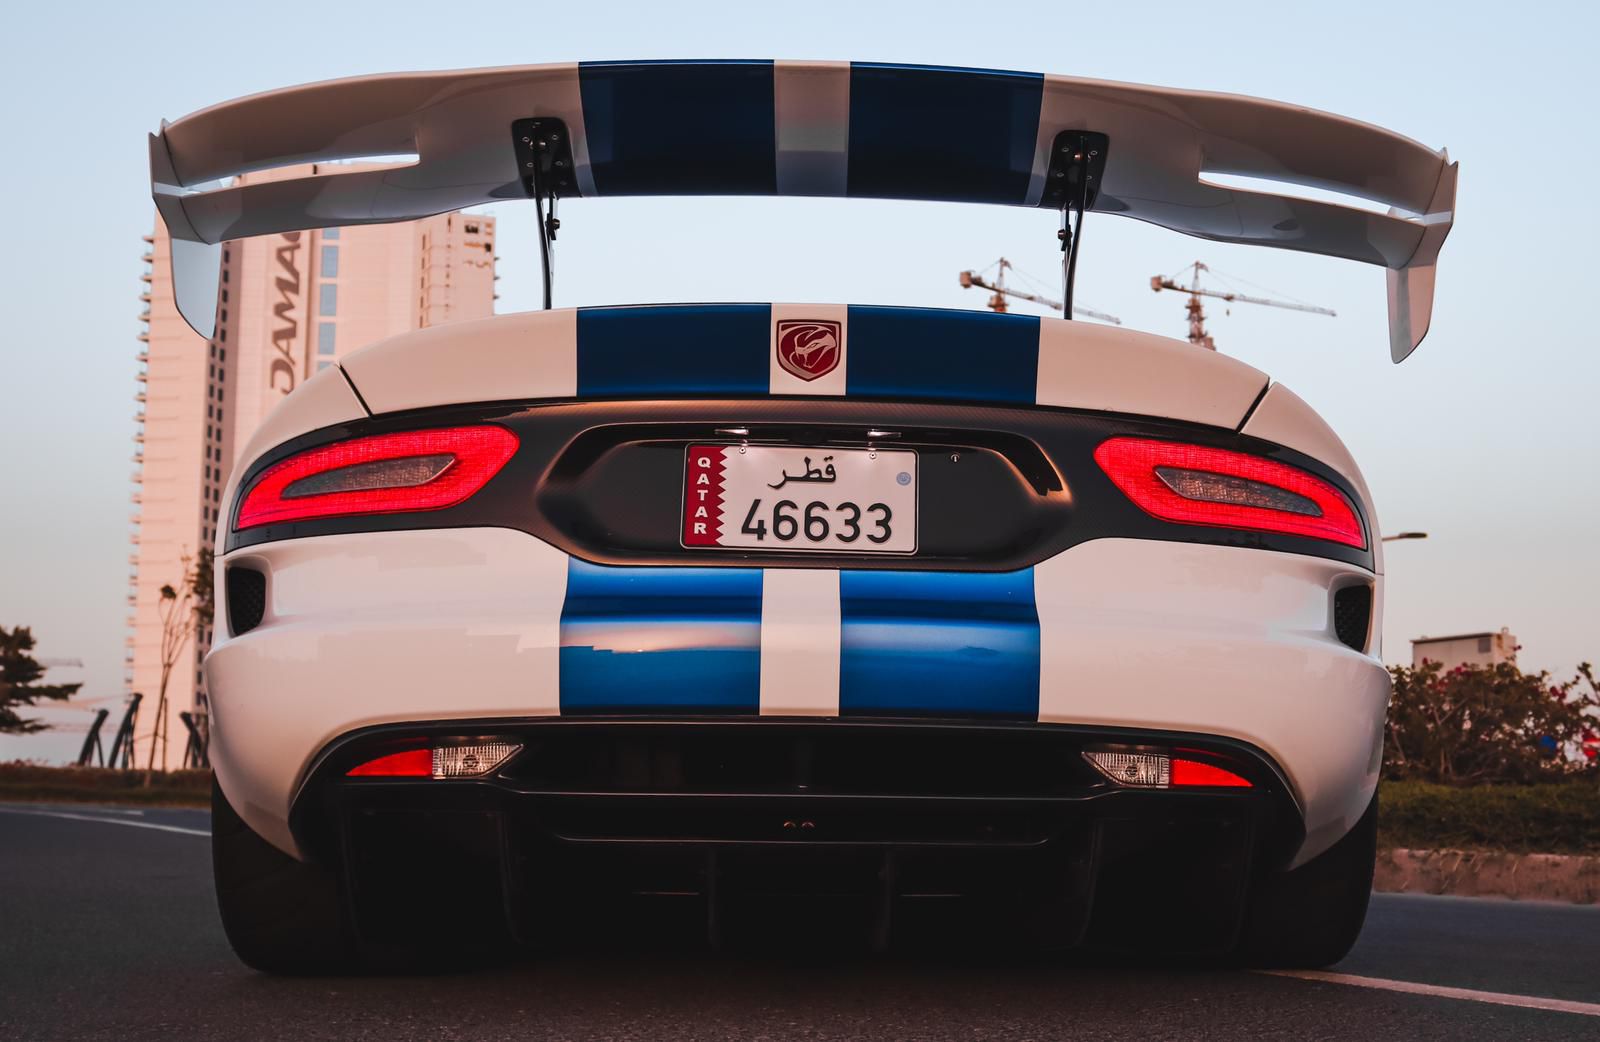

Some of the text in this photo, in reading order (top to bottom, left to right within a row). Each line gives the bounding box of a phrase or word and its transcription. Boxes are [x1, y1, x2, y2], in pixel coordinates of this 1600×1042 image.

[767, 455, 837, 490] قطر
[693, 457, 711, 534] QATAR
[741, 499, 893, 544] 46633
